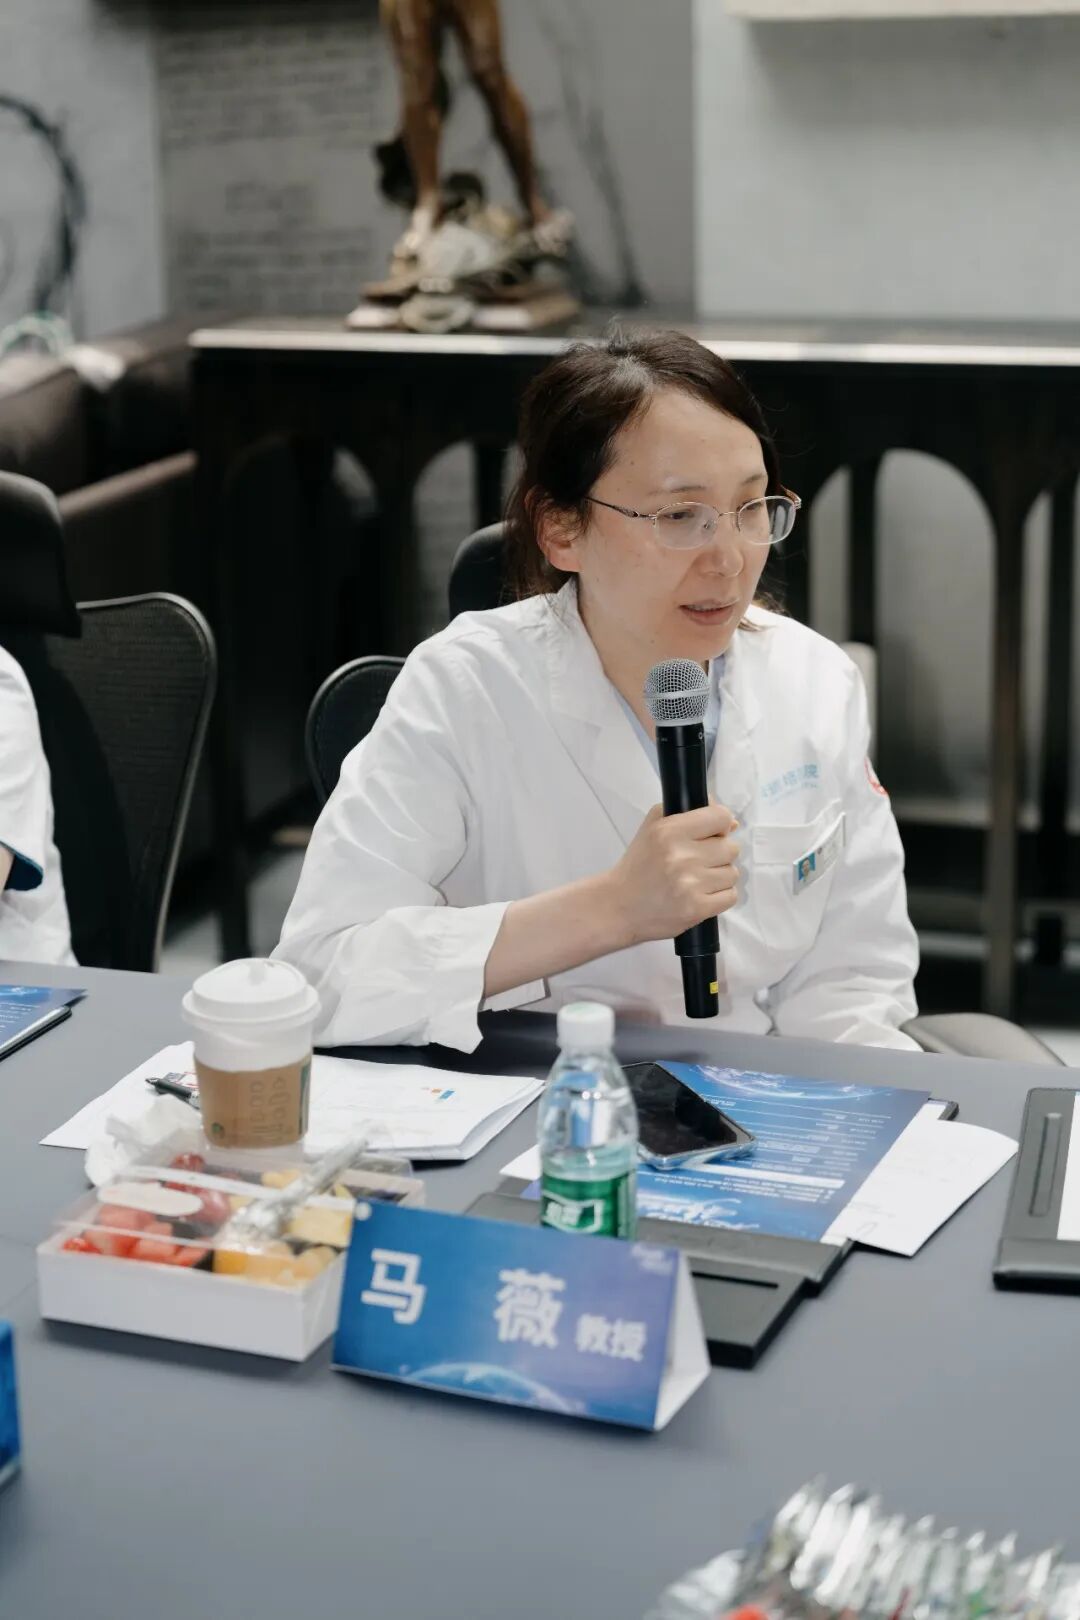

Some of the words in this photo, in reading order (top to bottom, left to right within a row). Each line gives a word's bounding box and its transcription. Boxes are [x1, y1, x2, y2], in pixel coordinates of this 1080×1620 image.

[361, 1248, 427, 1324] 马
[493, 1269, 566, 1348] 薇
[575, 1313, 648, 1362] 教授
